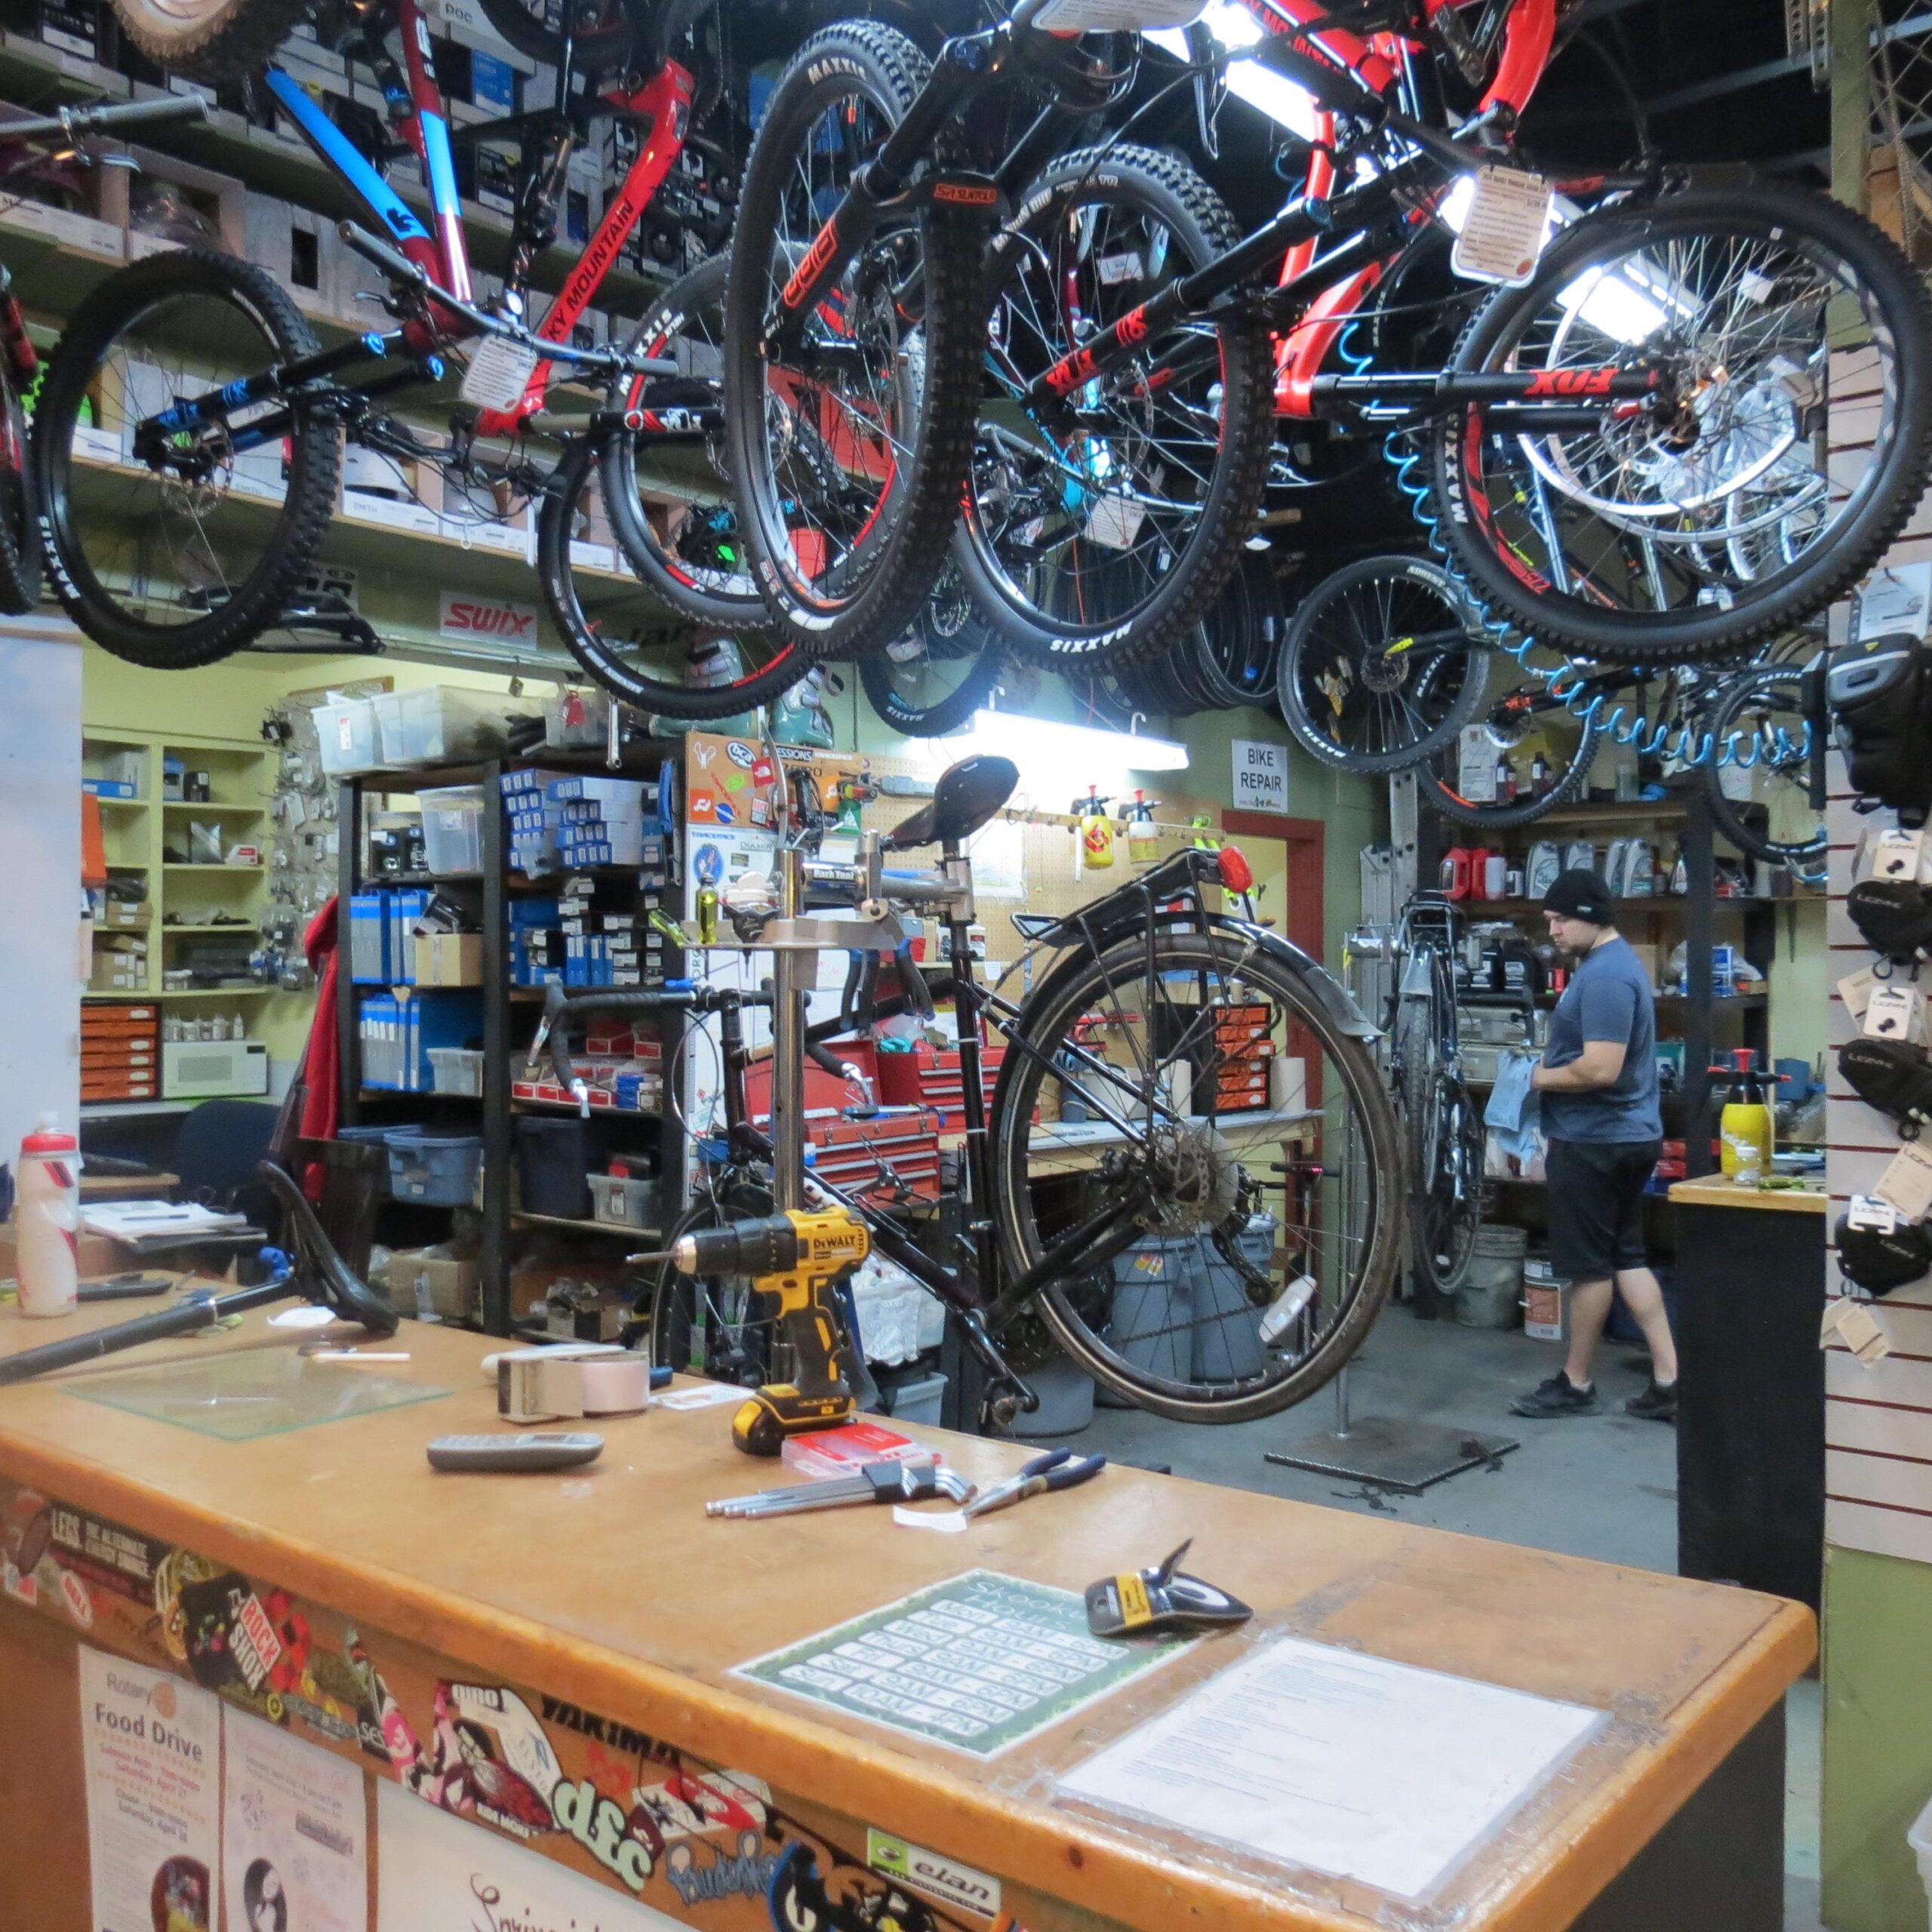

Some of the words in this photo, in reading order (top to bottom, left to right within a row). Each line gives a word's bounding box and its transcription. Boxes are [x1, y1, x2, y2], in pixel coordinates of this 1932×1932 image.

[566, 198, 635, 312] MOUNTAIN
[618, 308, 672, 397] MXXIS
[1524, 369, 1620, 396] FOX
[1444, 414, 1469, 524] MAXXIS
[444, 603, 534, 638] SWIX
[1050, 620, 1134, 654] MAXXIS
[887, 706, 926, 721] MAXXIS
[731, 744, 754, 762] bca
[775, 747, 814, 761] ESSIONS
[1247, 748, 1274, 767] BIKE
[1302, 725, 1346, 758] MAXXIS
[1241, 771, 1282, 792] REPAIR
[814, 869, 835, 879] Park
[835, 870, 854, 881] Tool
[243, 1598, 278, 1670] ROCK
[106, 1672, 151, 1706] Rotary
[95, 1701, 146, 1738] Food
[152, 1721, 203, 1764] Drive
[541, 1693, 681, 1767] YAKIMA
[915, 1862, 990, 1900] elan
